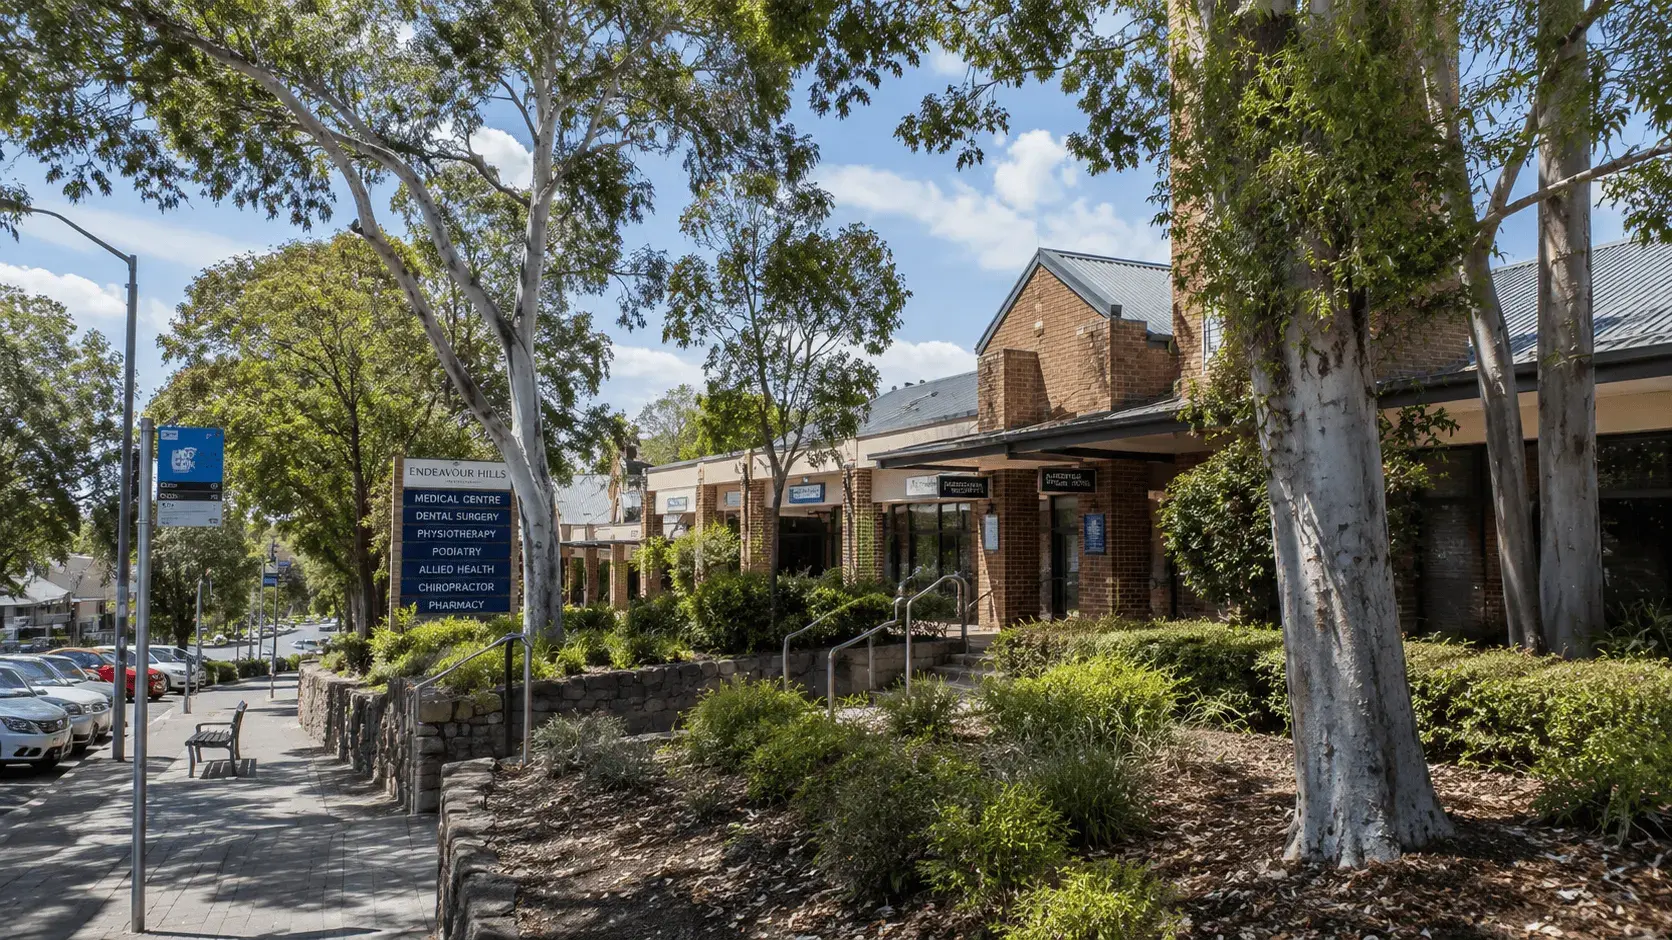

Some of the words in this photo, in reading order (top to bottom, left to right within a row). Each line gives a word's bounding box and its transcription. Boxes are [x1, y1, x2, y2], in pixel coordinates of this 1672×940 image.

[409, 467, 474, 478] ENDEAVOUR
[477, 469, 507, 479] HILLS
[414, 494, 459, 504] MEDICAL
[462, 495, 501, 505] CENTRE
[416, 511, 453, 521] DENTAL
[456, 512, 499, 521] SURGERY
[417, 529, 496, 538] PHYSIOTHERAPY
[432, 547, 482, 556] PODIATRY
[457, 564, 495, 574] HEALTH
[418, 582, 495, 592] CHIROPRACTOR
[428, 600, 485, 609] PHARMACY
